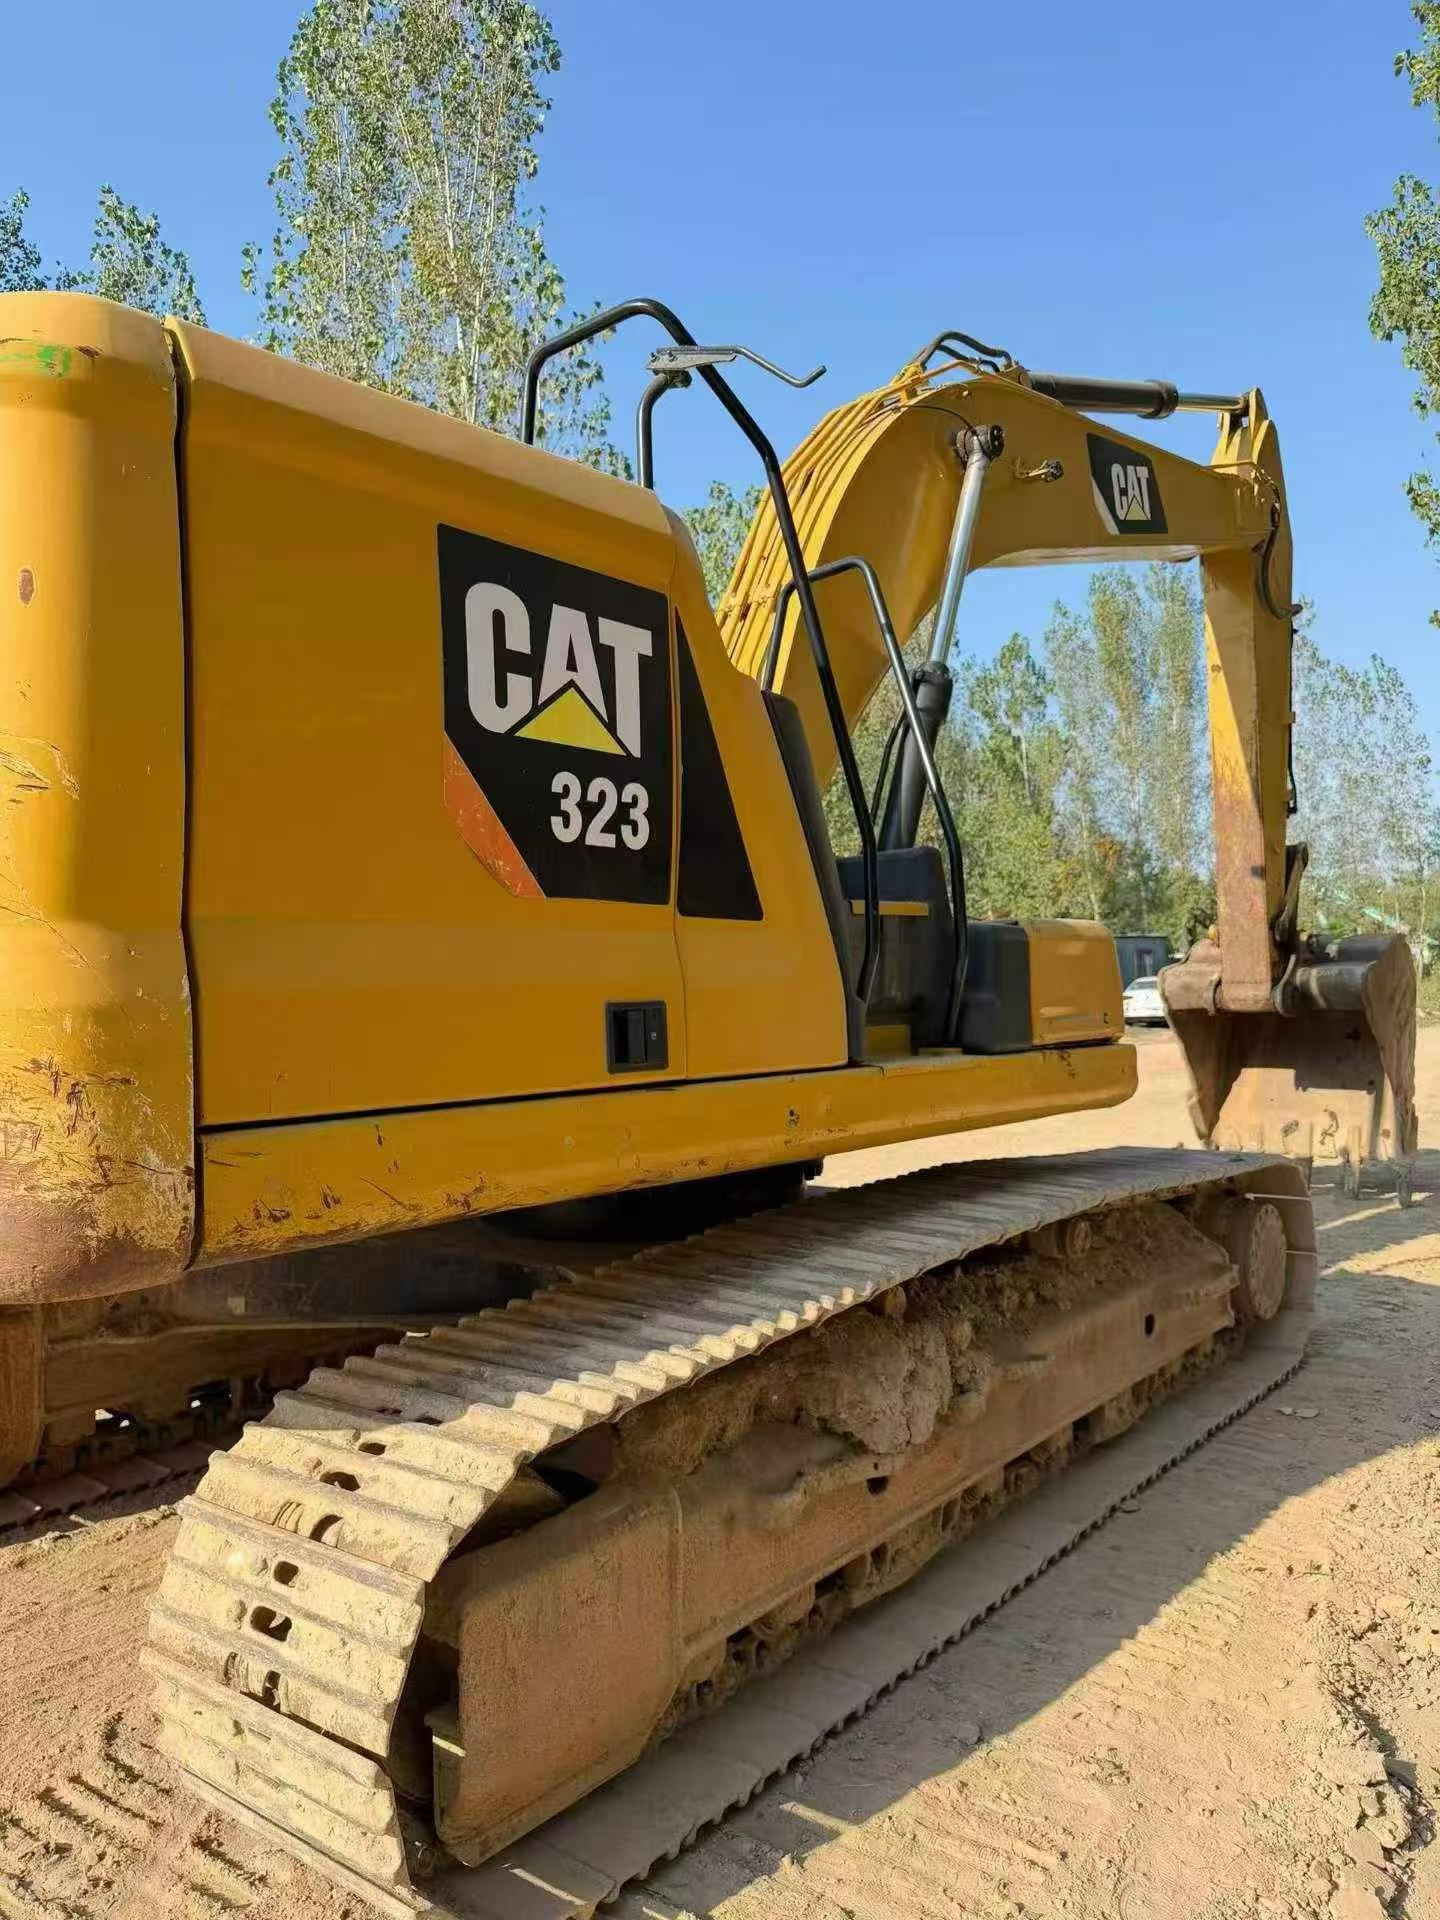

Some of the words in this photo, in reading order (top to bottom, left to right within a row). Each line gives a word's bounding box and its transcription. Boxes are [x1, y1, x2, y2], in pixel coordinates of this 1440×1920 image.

[1111, 463, 1151, 520] CAT
[465, 582, 652, 758] CAT
[551, 771, 649, 850] 323
